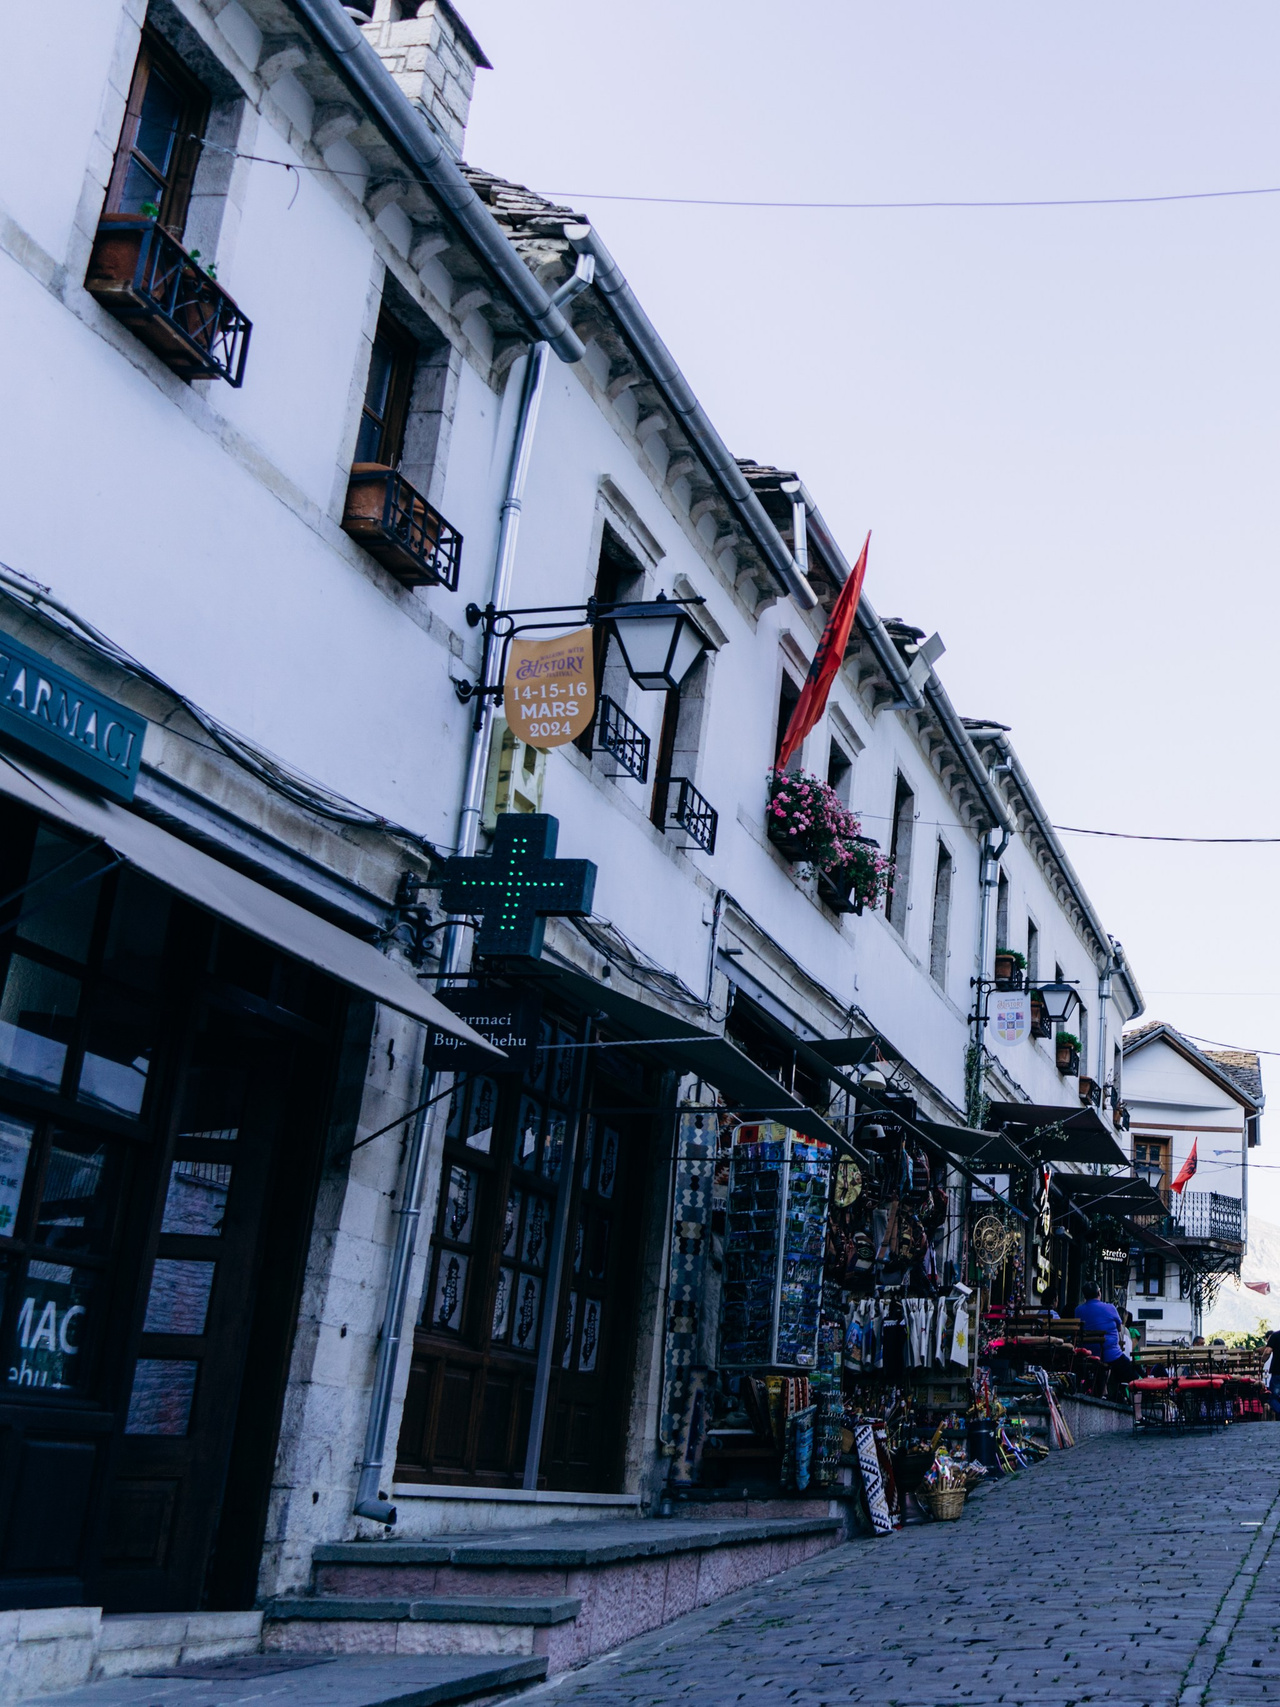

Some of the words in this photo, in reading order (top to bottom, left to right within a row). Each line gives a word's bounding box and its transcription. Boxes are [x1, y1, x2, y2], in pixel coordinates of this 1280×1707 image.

[516, 656, 585, 680] HISTORY
[514, 682, 588, 701] 14-15-16
[521, 701, 579, 720] MARS
[530, 721, 571, 737] 2024
[453, 1012, 512, 1025] armaci
[1102, 1247, 1127, 1259] Stretto
[449, 1268, 457, 1305] SOON
[443, 1279, 452, 1319] COMING
[495, 1280, 504, 1316] SOON
